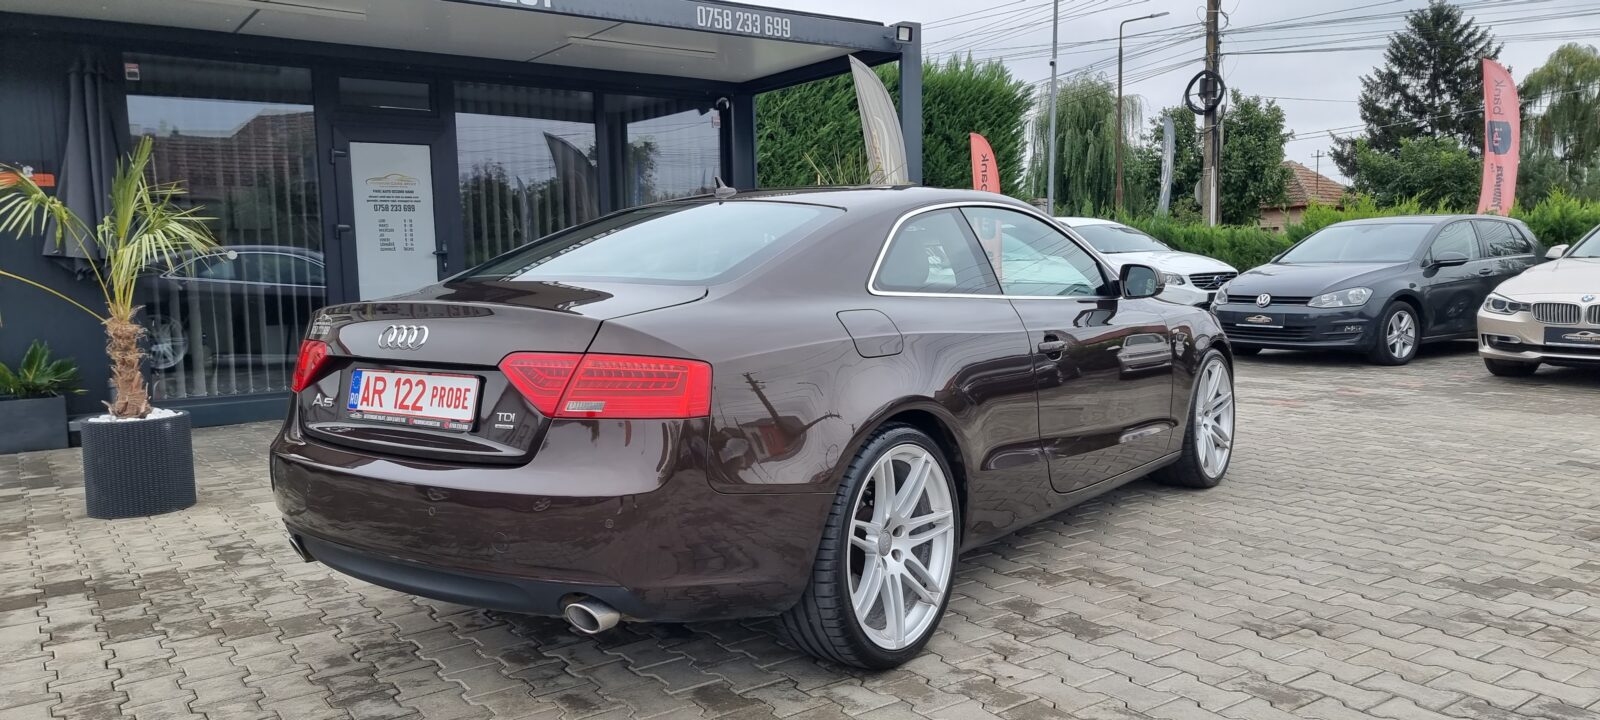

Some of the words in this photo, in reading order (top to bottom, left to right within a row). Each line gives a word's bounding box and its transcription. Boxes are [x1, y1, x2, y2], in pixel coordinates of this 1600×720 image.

[697, 6, 732, 30] 0758
[736, 12, 760, 34] 233
[765, 16, 790, 37] 699
[373, 204, 390, 212] 0758
[390, 204, 402, 212] 233
[404, 204, 415, 212] 699
[311, 393, 335, 408] A5
[350, 392, 359, 405] RO
[359, 375, 387, 408] AR
[393, 377, 427, 412] 122
[429, 385, 471, 410] PROBE
[496, 412, 516, 423] TDI
